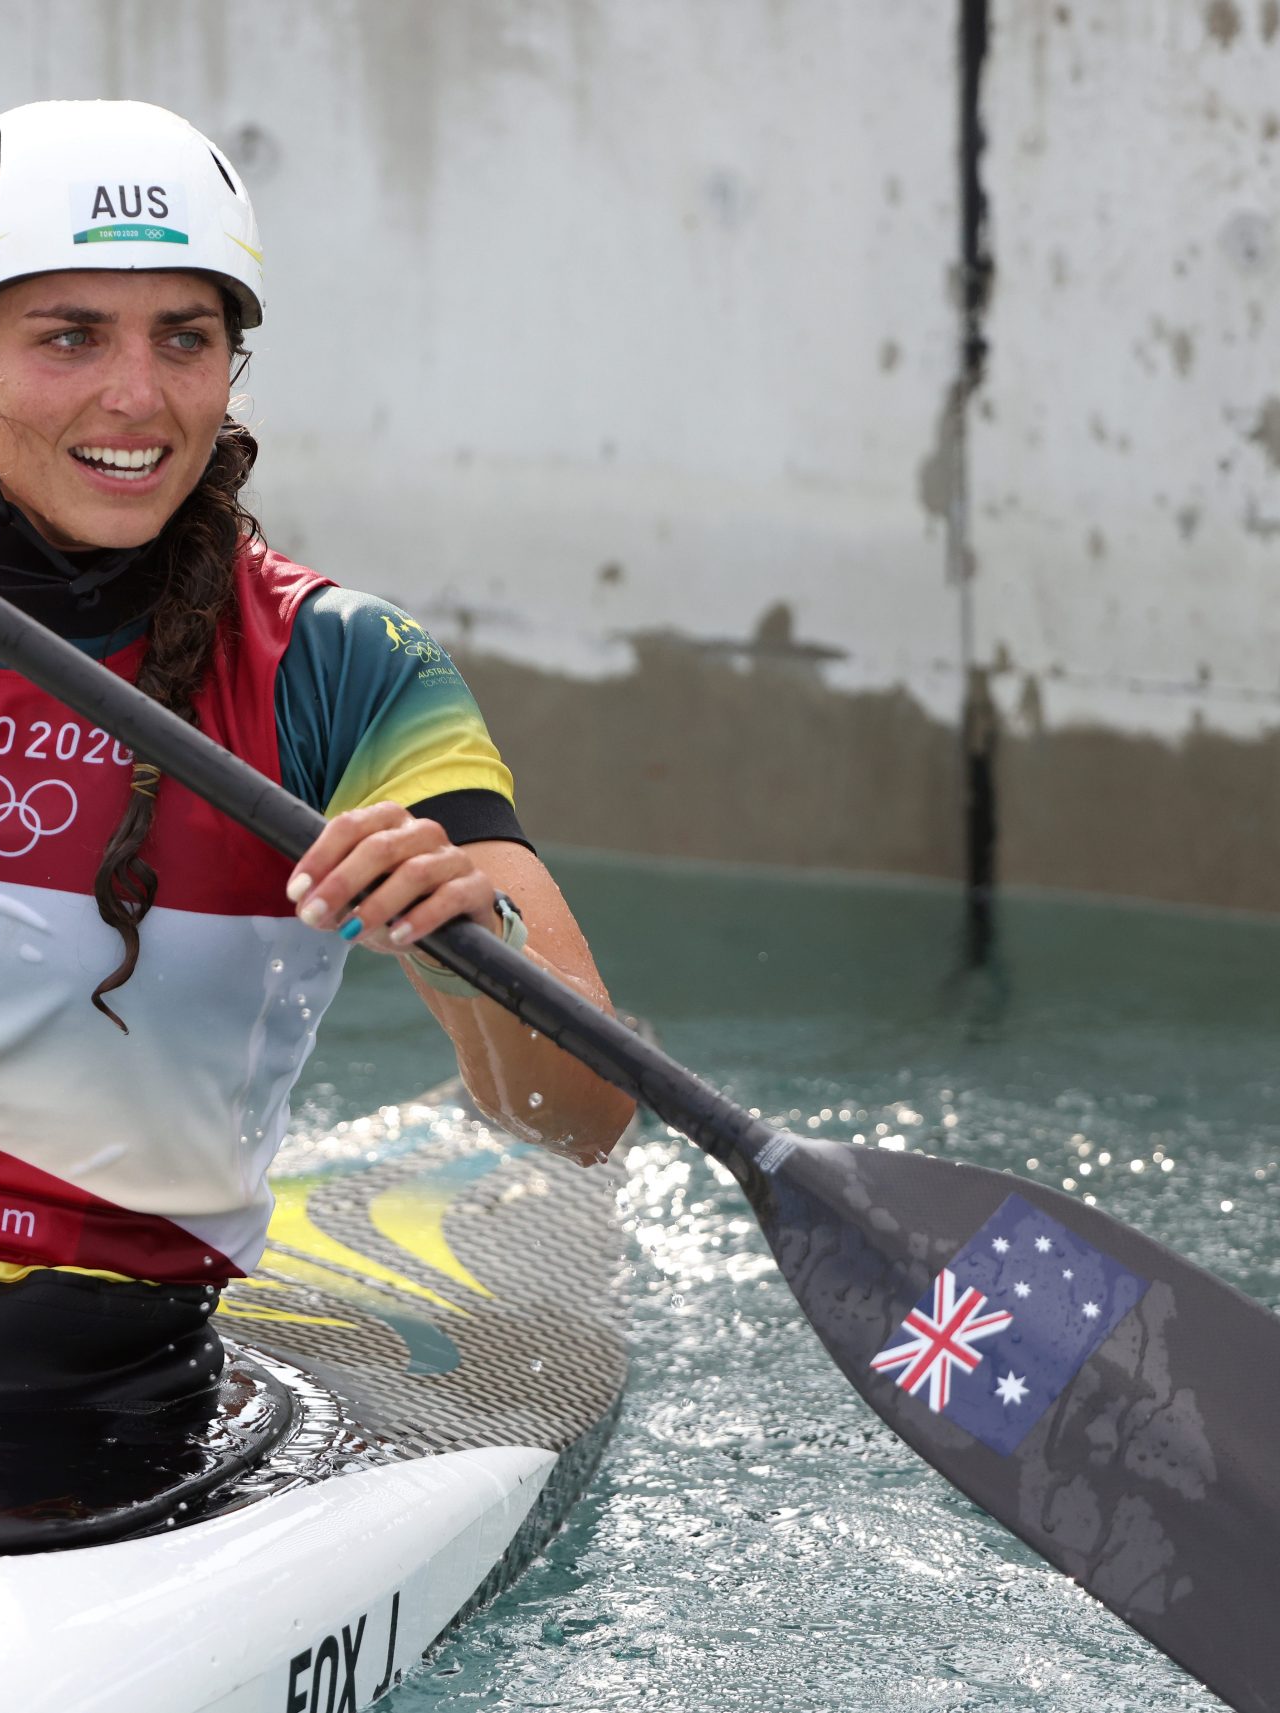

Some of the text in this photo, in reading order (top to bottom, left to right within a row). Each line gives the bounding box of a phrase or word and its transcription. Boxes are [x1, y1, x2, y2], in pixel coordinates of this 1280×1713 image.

[91, 184, 169, 219] AUS
[99, 229, 139, 238] TOKYO 2020
[285, 1612, 368, 1713] FOX
